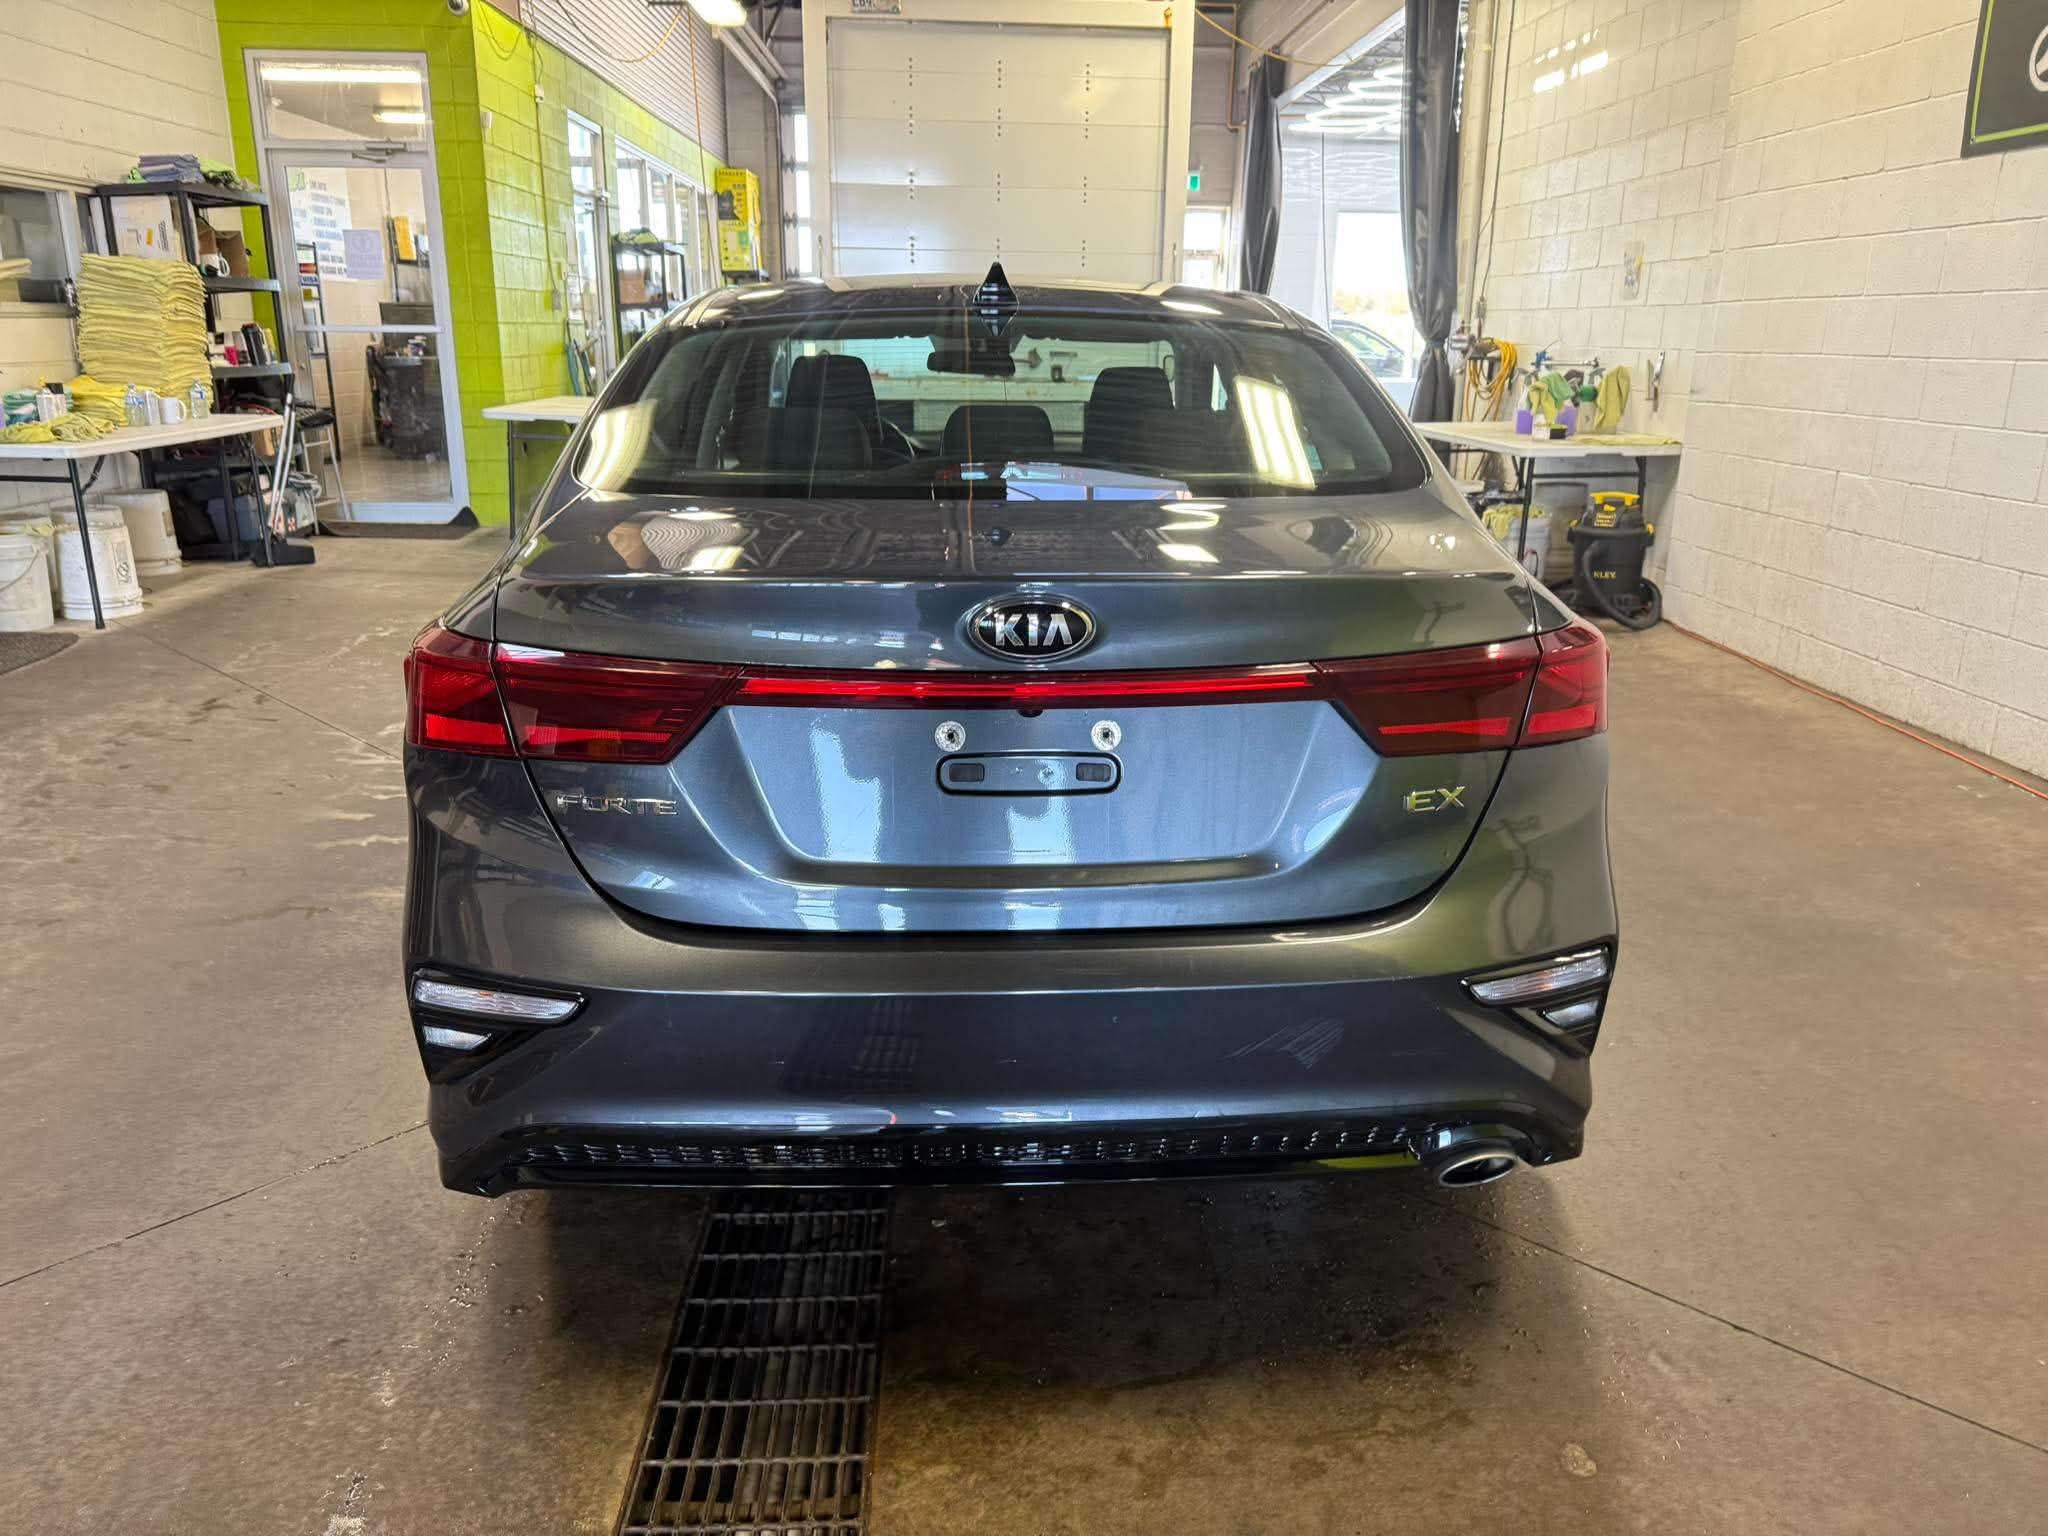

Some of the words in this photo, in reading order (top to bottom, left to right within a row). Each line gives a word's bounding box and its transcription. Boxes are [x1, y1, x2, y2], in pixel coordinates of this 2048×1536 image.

[994, 612, 1073, 646] KIA
[556, 794, 678, 816] FORTE
[1403, 785, 1466, 812] EX
